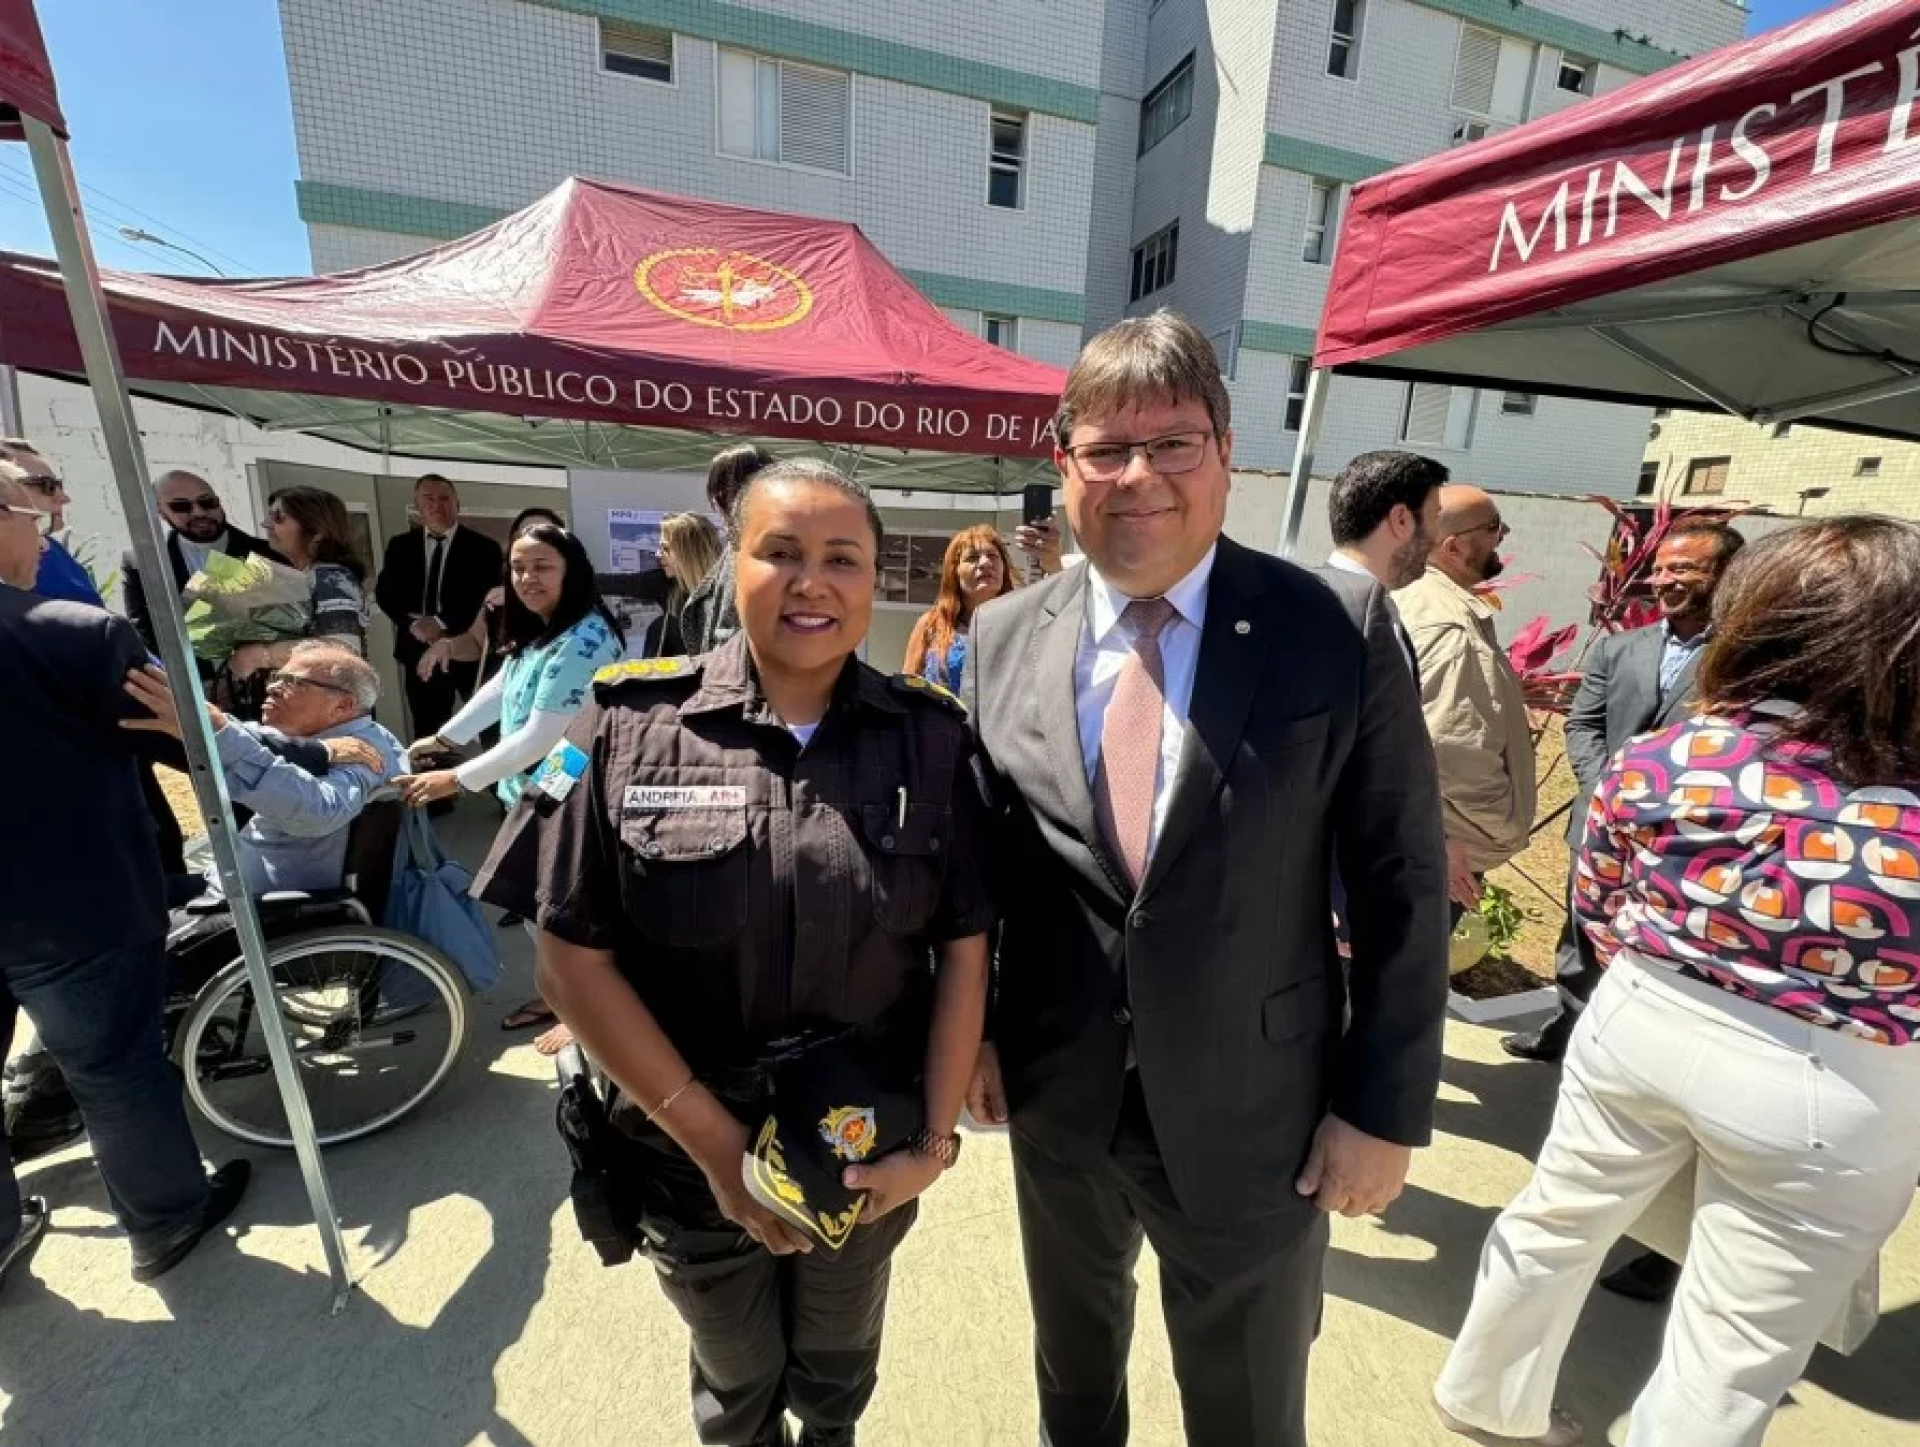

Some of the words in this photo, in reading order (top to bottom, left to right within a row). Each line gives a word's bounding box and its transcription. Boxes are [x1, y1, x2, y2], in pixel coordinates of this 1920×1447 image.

[153, 320, 428, 385] MINISTÉRIO
[442, 353, 618, 405] PÚBLICO
[634, 379, 693, 413] DO
[706, 387, 842, 427] ESTADO
[854, 400, 905, 432] DO
[915, 406, 970, 437] RIO
[985, 412, 1023, 441] DE
